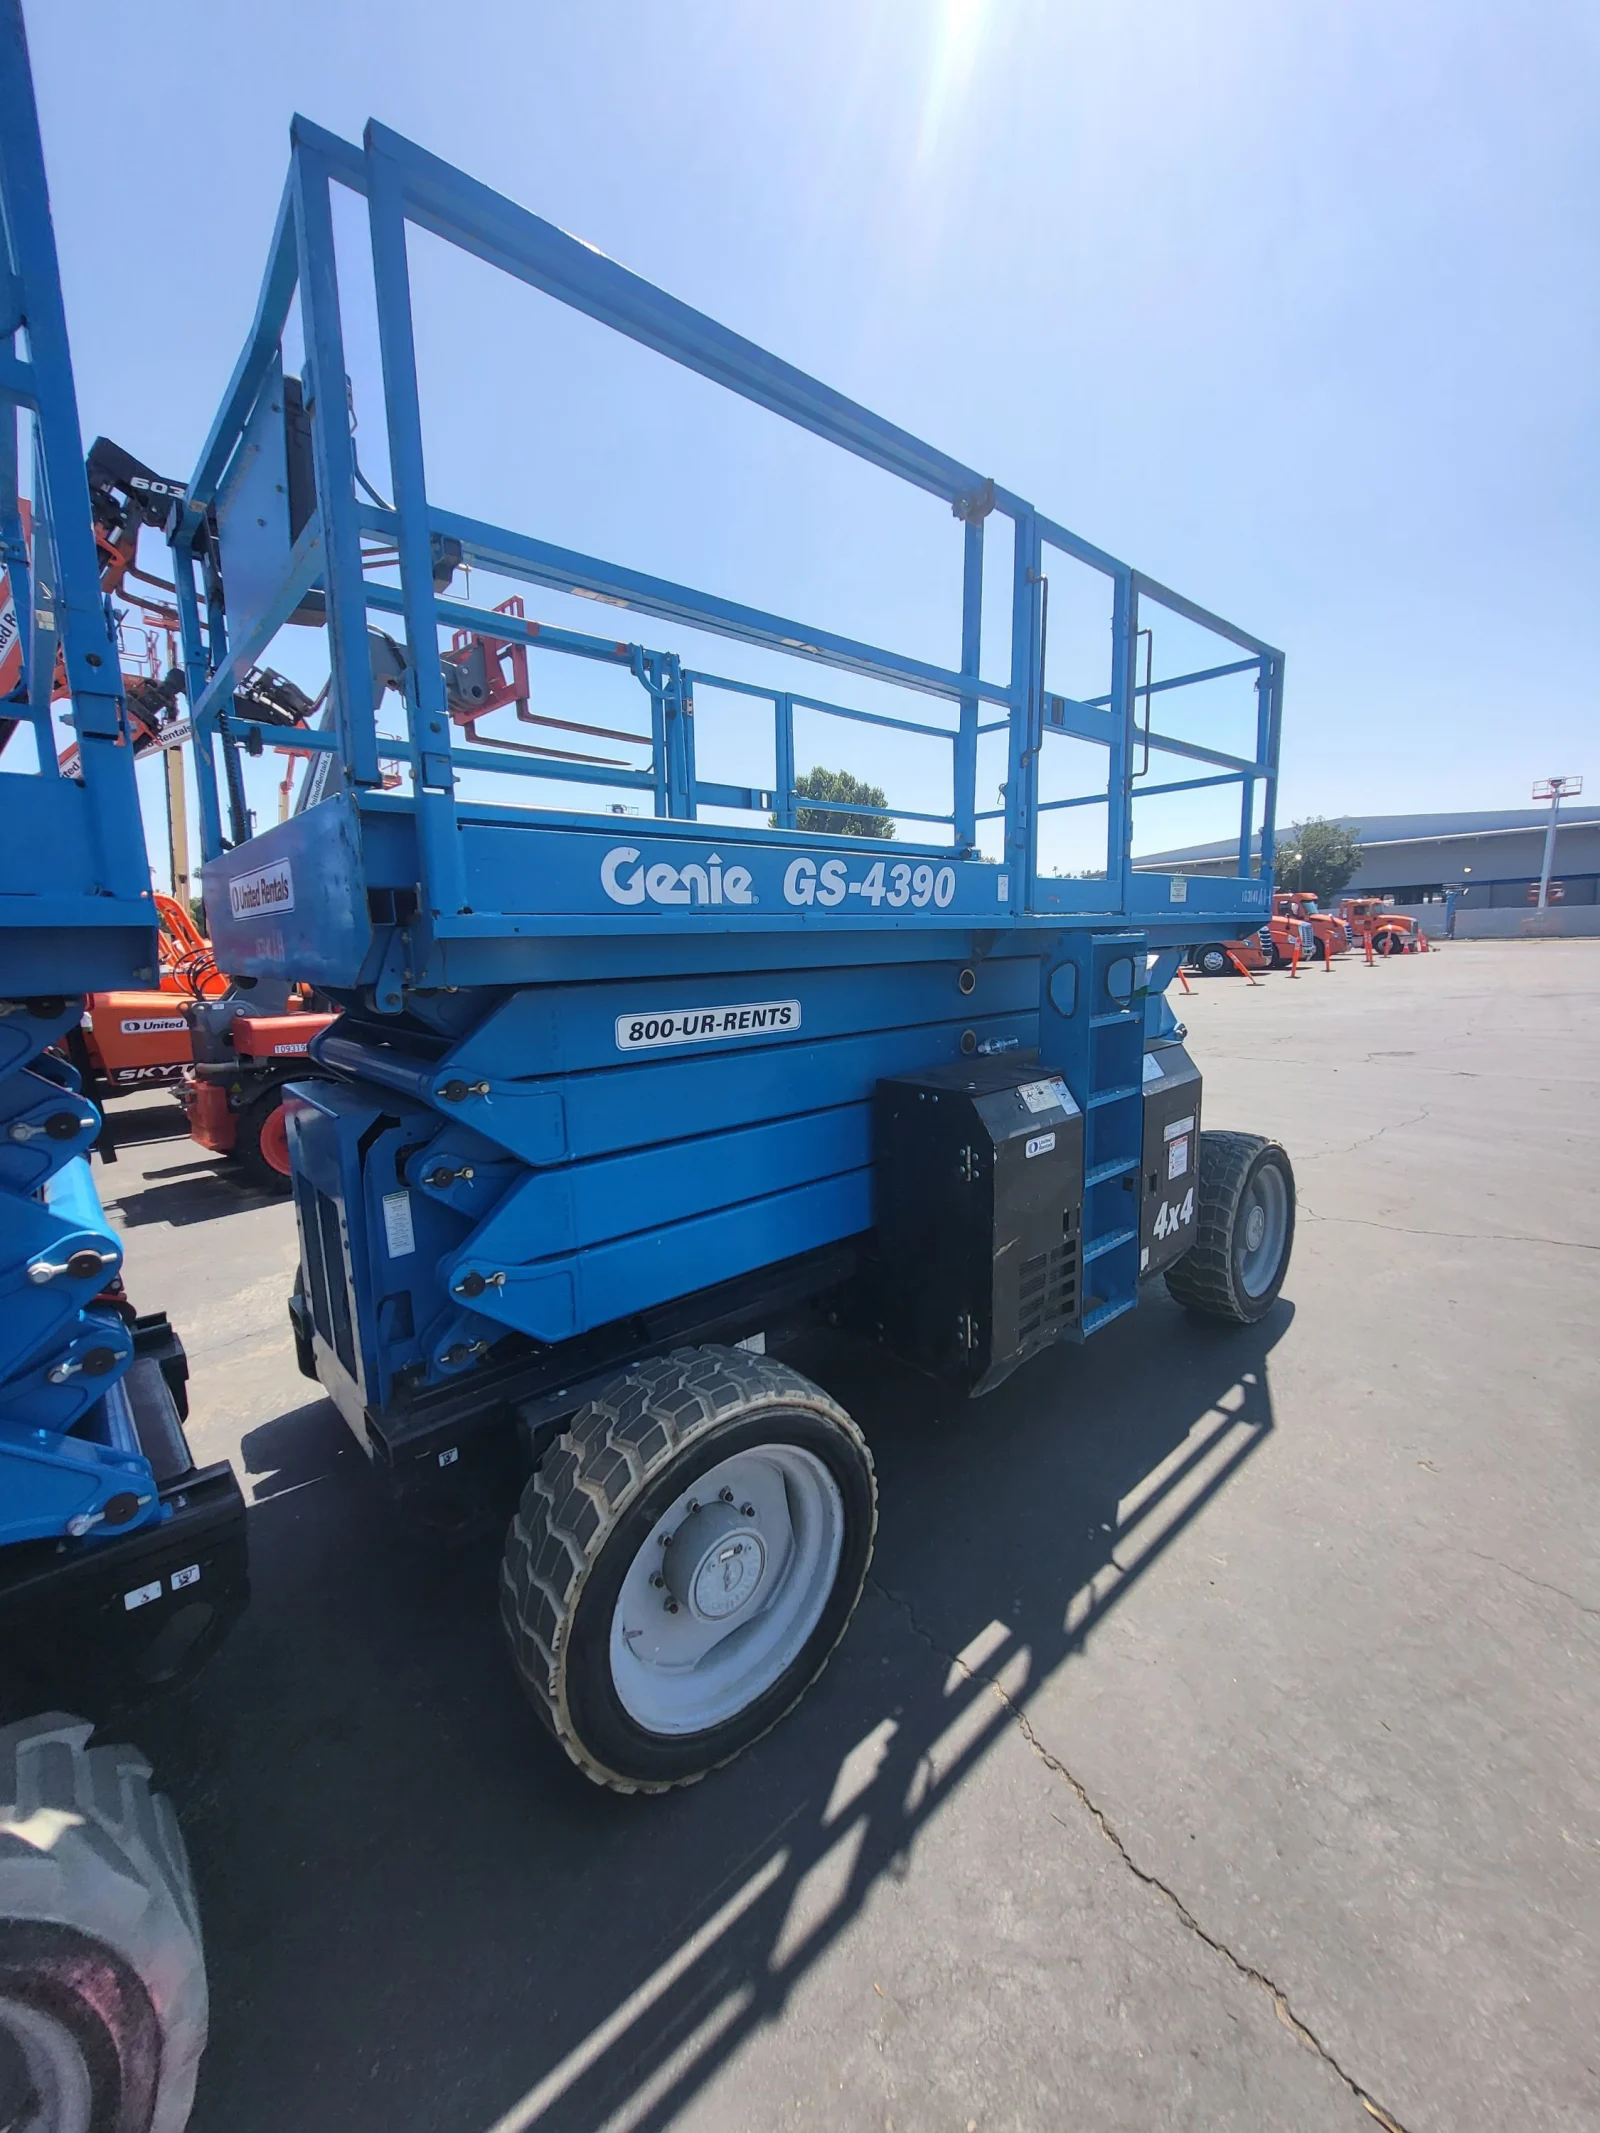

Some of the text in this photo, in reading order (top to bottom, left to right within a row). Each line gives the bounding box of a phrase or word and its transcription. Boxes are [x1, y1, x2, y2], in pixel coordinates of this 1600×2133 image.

[130, 477, 186, 500] 603
[239, 872, 289, 910] United Rentals
[600, 846, 754, 906] Genie
[783, 857, 956, 908] GS-4390
[143, 1016, 184, 1031] United
[628, 1006, 792, 1042] 800-UR-RENTS
[1153, 1187, 1194, 1241] 4x4
